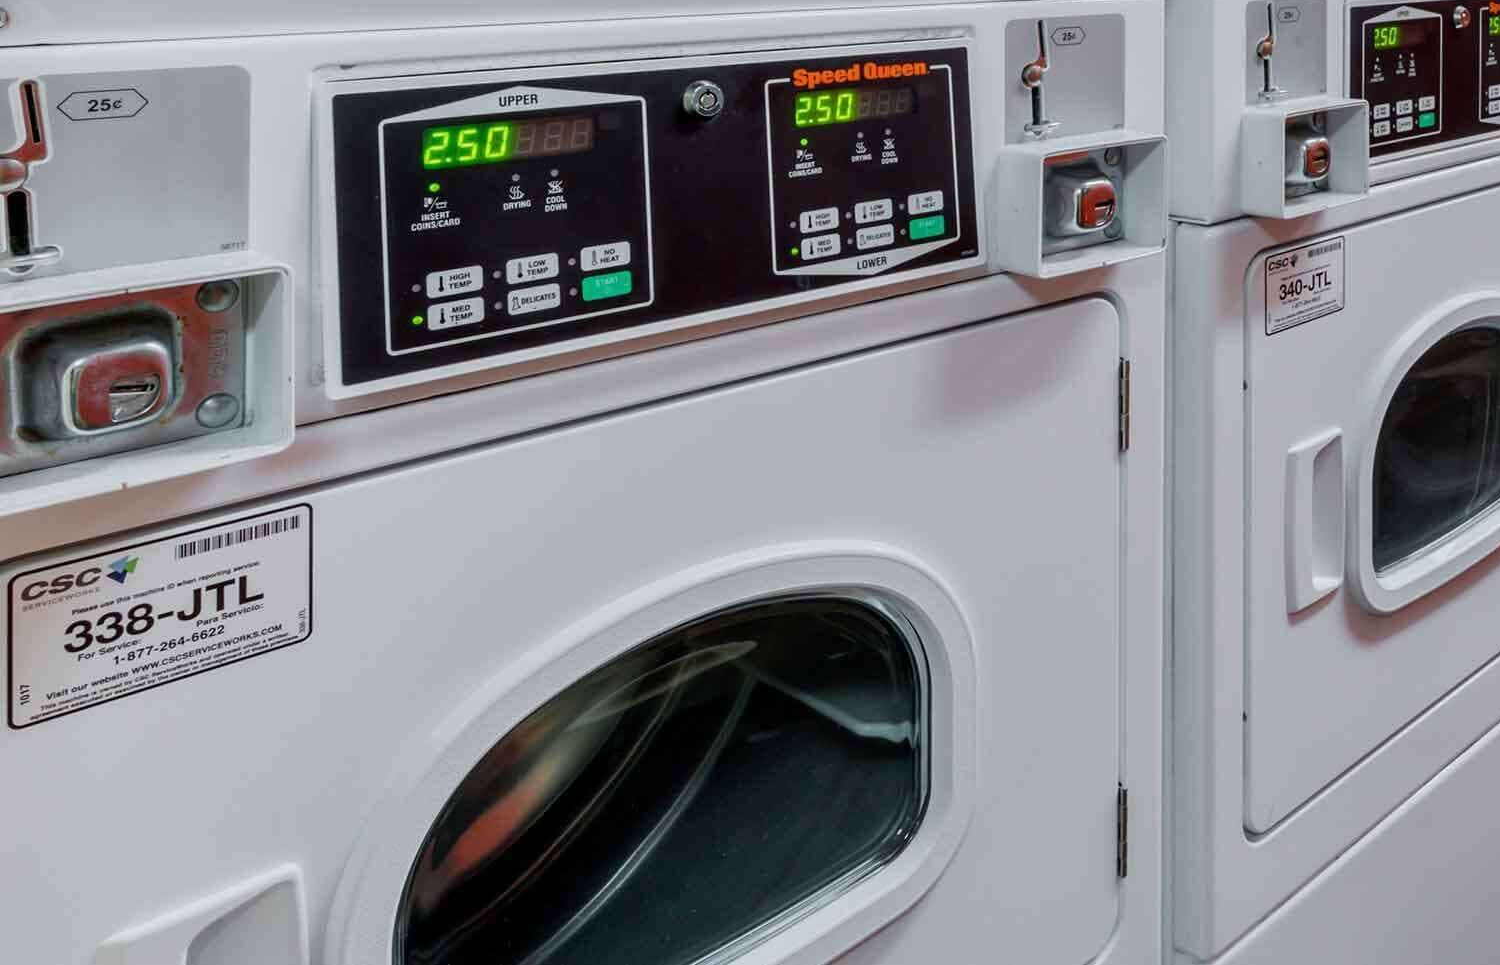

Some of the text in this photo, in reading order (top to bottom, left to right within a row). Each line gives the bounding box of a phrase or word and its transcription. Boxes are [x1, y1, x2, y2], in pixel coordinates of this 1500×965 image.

[793, 61, 928, 88] Speed Queen
[87, 97, 123, 113] 25¢
[498, 94, 538, 108] UPPER
[795, 93, 854, 125] 2.50
[423, 125, 510, 165] 2.50
[851, 154, 872, 162] DRYING
[503, 200, 532, 210] DRYING
[546, 195, 565, 205] COOL
[545, 202, 568, 212] DOWN
[421, 212, 450, 221] INSERT
[815, 218, 831, 227] TEMP
[411, 217, 461, 231] COINS/CARD
[816, 245, 832, 253] TEMP
[528, 260, 546, 268] LOW
[600, 255, 620, 265] HEAT
[857, 256, 888, 270] LOWER
[1268, 257, 1289, 271] CSC
[449, 272, 471, 282] HIGH
[527, 267, 549, 276] TEMP
[449, 280, 472, 290] TEMP
[595, 277, 619, 287] START
[1279, 271, 1332, 301] 340-JTL
[521, 293, 556, 304] DELICATES
[452, 304, 471, 313] MED
[450, 312, 473, 322] TEMP
[20, 566, 103, 602] CSC
[63, 574, 265, 654] 338-JTL
[196, 603, 264, 627] Para Servicio:
[77, 638, 142, 661] For Service:
[113, 624, 226, 665] 1-877-264-6622
[46, 686, 68, 700] Visit
[71, 682, 87, 693] our
[91, 668, 128, 687] website
[20, 684, 31, 705] 1017
